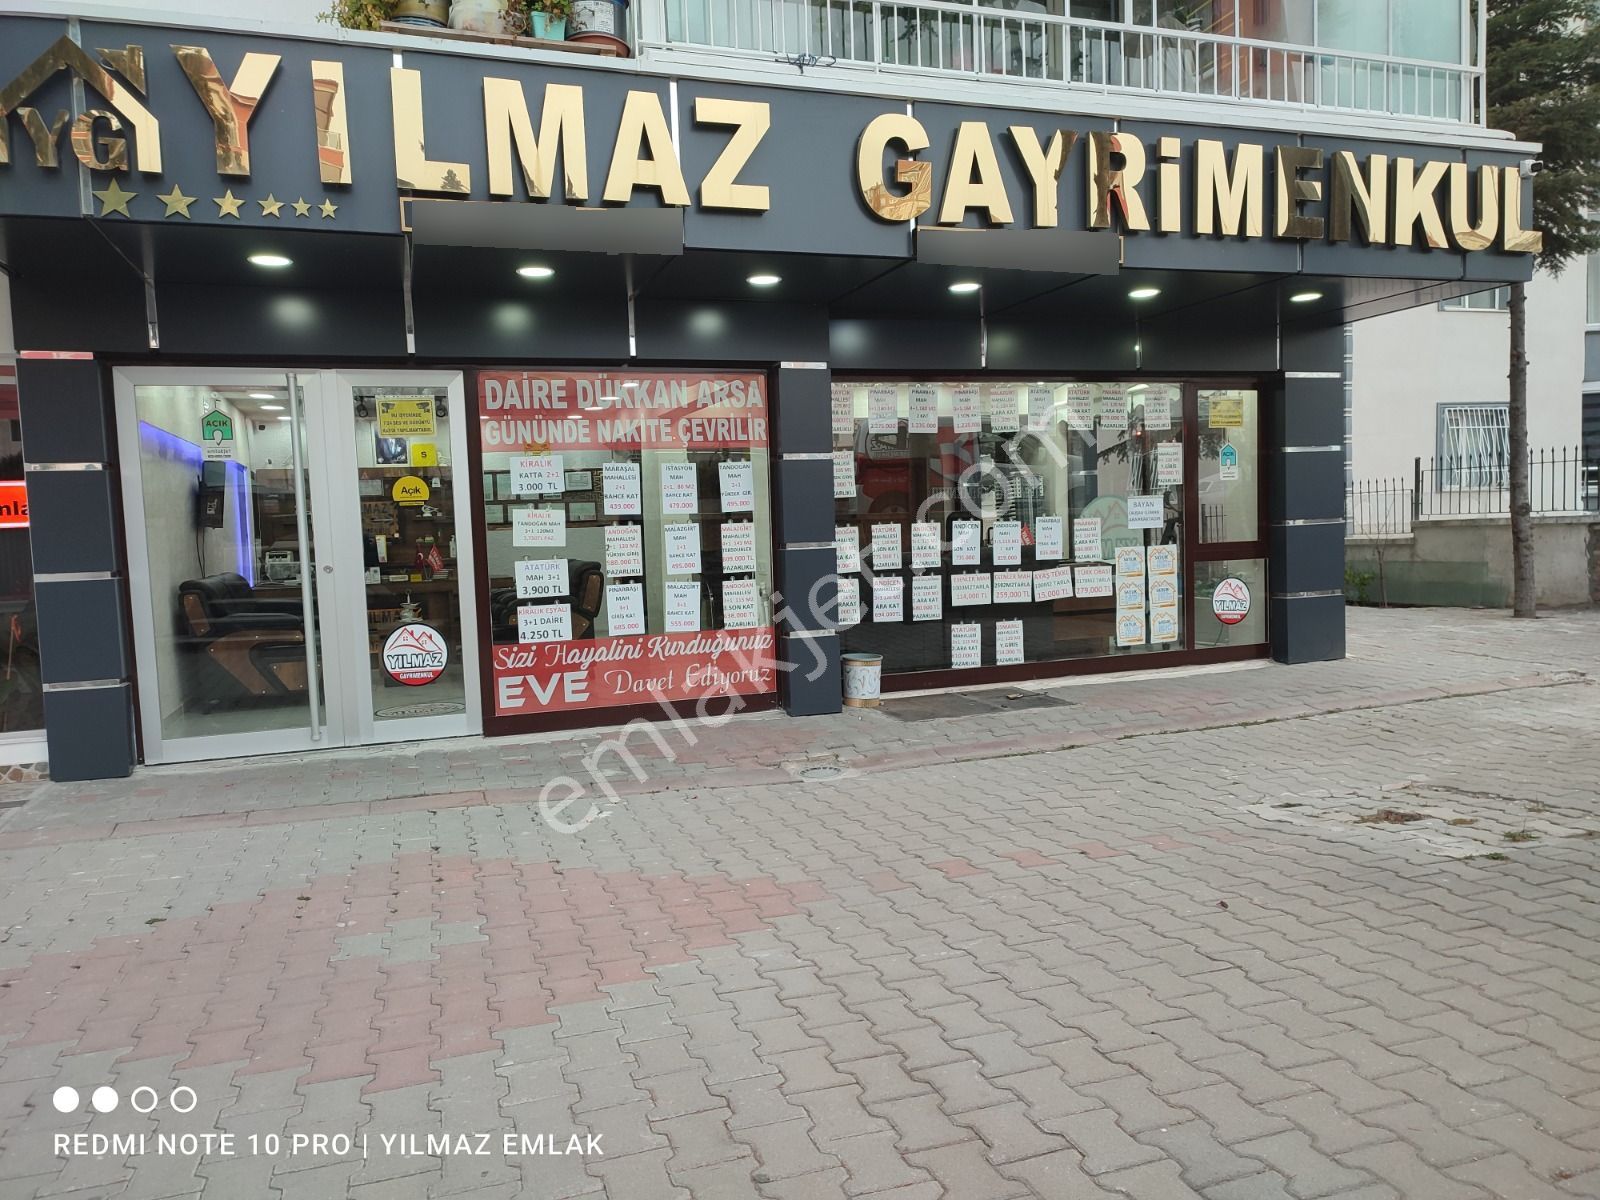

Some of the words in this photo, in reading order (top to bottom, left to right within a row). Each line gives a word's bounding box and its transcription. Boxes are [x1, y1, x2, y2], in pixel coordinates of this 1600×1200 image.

[169, 44, 771, 210] YILMAZ
[484, 372, 568, 410] DAİRE
[576, 373, 688, 409] DÜKKAN
[696, 380, 764, 408] ARSA
[484, 415, 592, 445] GÜNÜNDE
[597, 413, 673, 443] NAKİTE
[678, 413, 768, 448] ÇEVRİLİR
[519, 459, 553, 468] KİRALIK
[401, 486, 421, 496] Açık
[519, 482, 543, 491] 3.000
[547, 482, 558, 490] TL
[524, 562, 560, 571] ATATÜRK
[522, 585, 550, 595] 3,900
[552, 585, 563, 594] TL
[518, 607, 544, 615] KİRALIK
[545, 606, 568, 615] EŞYALI
[1215, 600, 1247, 611] YILMAZ
[523, 618, 538, 627] 3+1
[540, 616, 564, 625] DAİRE
[520, 630, 549, 640] 4.250
[552, 630, 564, 638] TL
[494, 645, 537, 669] Sizi
[545, 640, 643, 671] Hayalini
[648, 630, 774, 659] Kurduğunuz
[387, 652, 443, 669] YILMAZ
[499, 670, 590, 709] EVE
[604, 668, 674, 694] Davet
[683, 660, 772, 694] Ediyoruz
